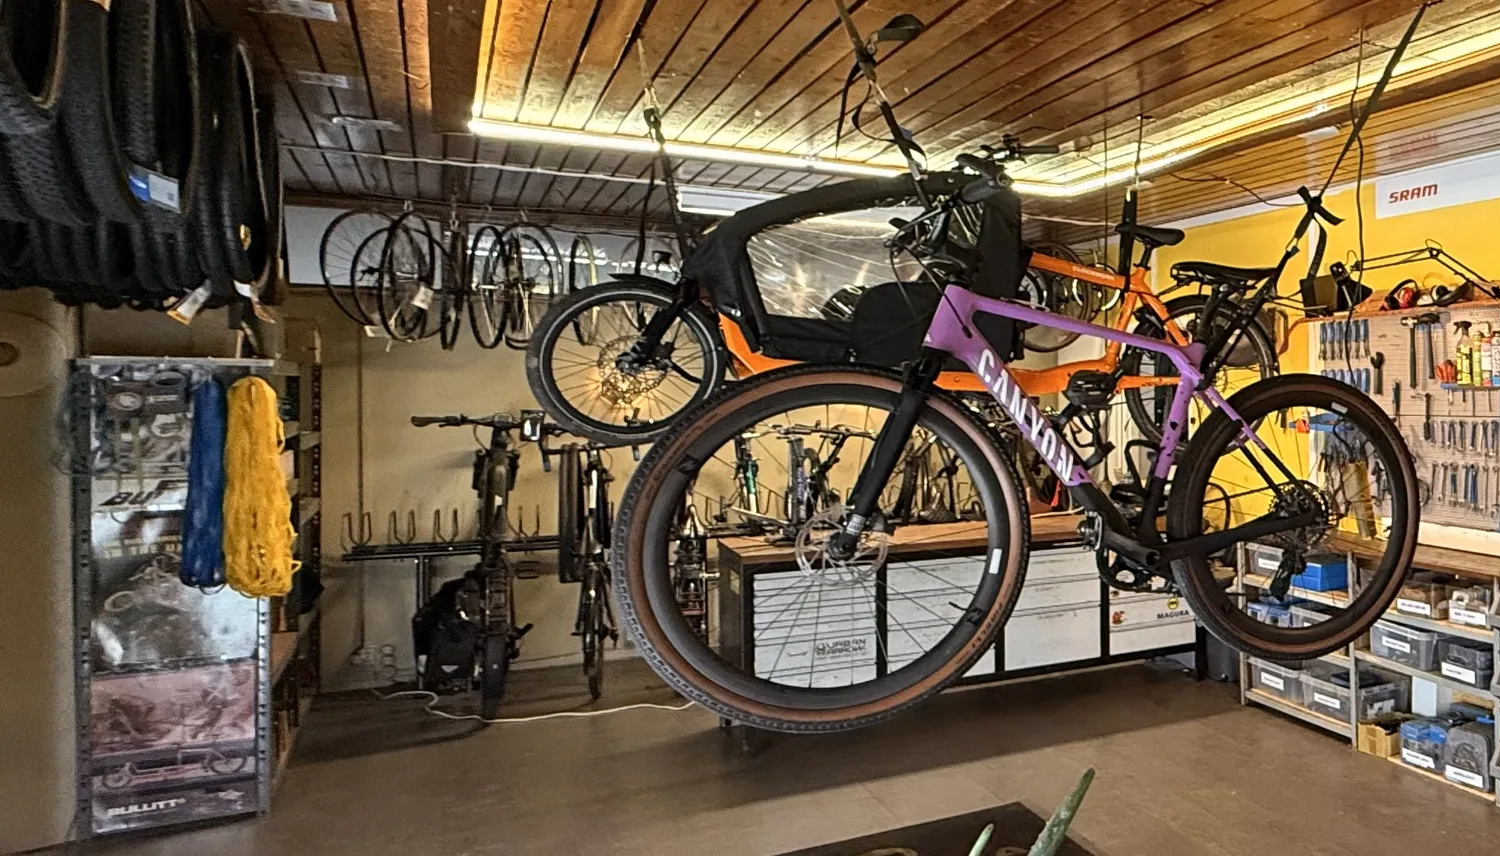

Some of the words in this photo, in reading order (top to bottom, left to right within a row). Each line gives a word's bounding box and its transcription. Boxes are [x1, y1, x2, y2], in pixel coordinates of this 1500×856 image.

[1388, 183, 1439, 204] SRAM
[978, 348, 1074, 483] CANYON
[1156, 609, 1190, 620] MAGURA
